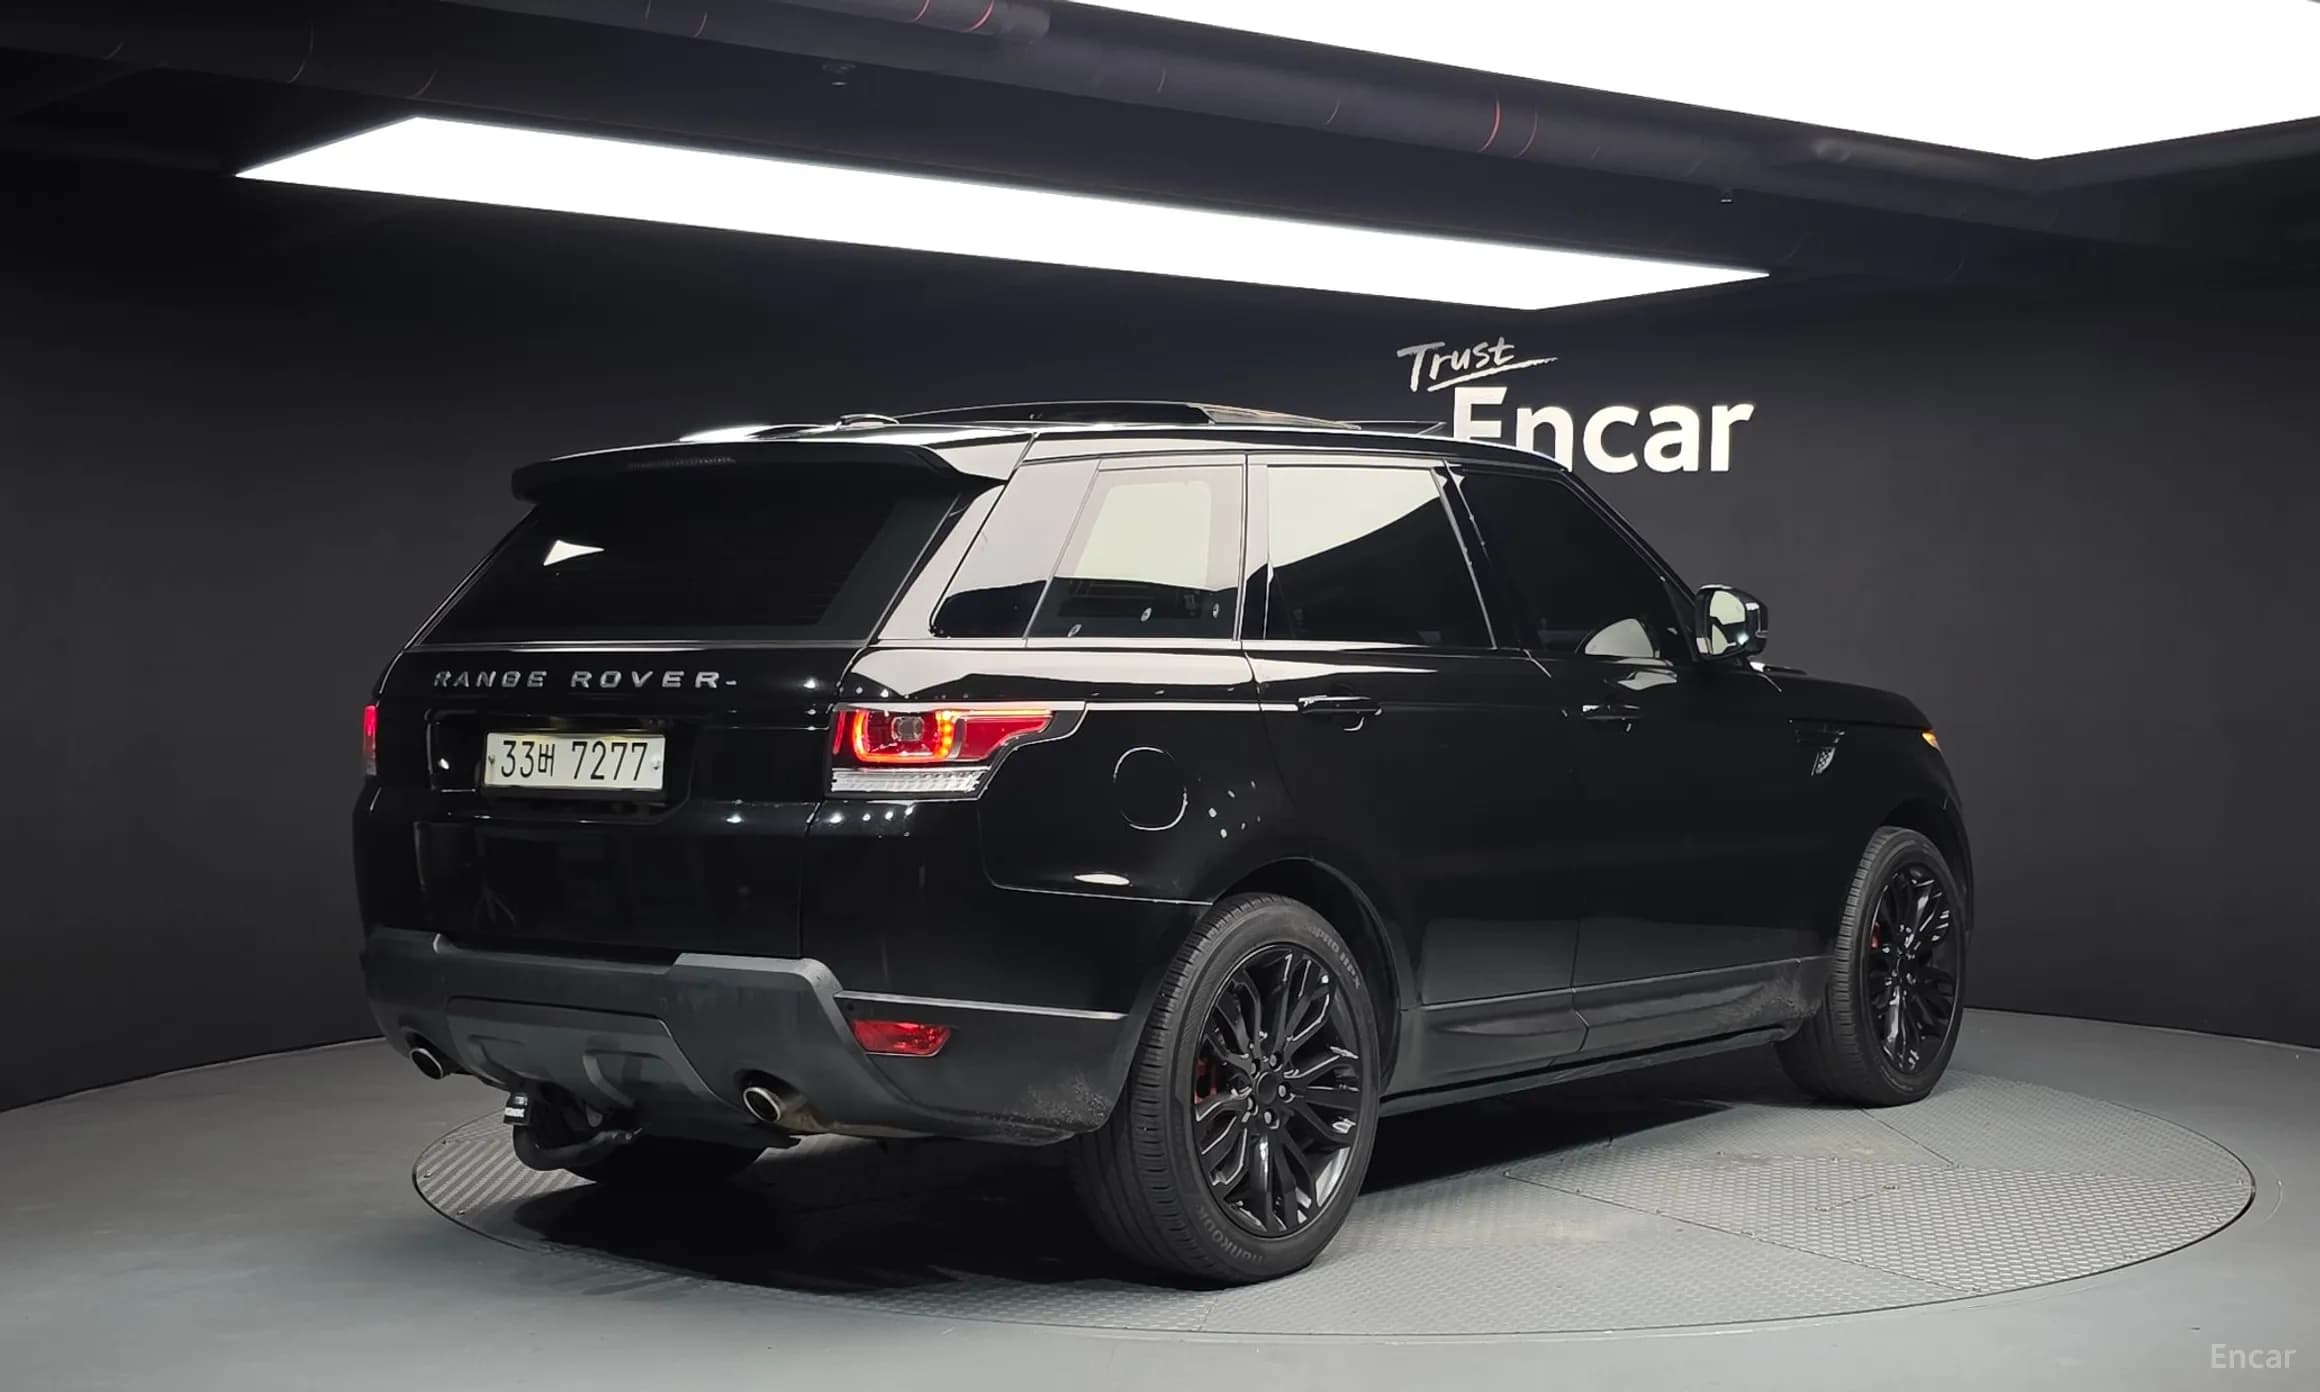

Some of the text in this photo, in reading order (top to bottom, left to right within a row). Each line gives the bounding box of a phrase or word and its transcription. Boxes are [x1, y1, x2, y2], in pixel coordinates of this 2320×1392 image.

[1397, 336, 1515, 392] Trust
[1453, 386, 1754, 473] Encar
[434, 671, 720, 688] RANGE ROVER
[501, 740, 649, 780] 33버 7277
